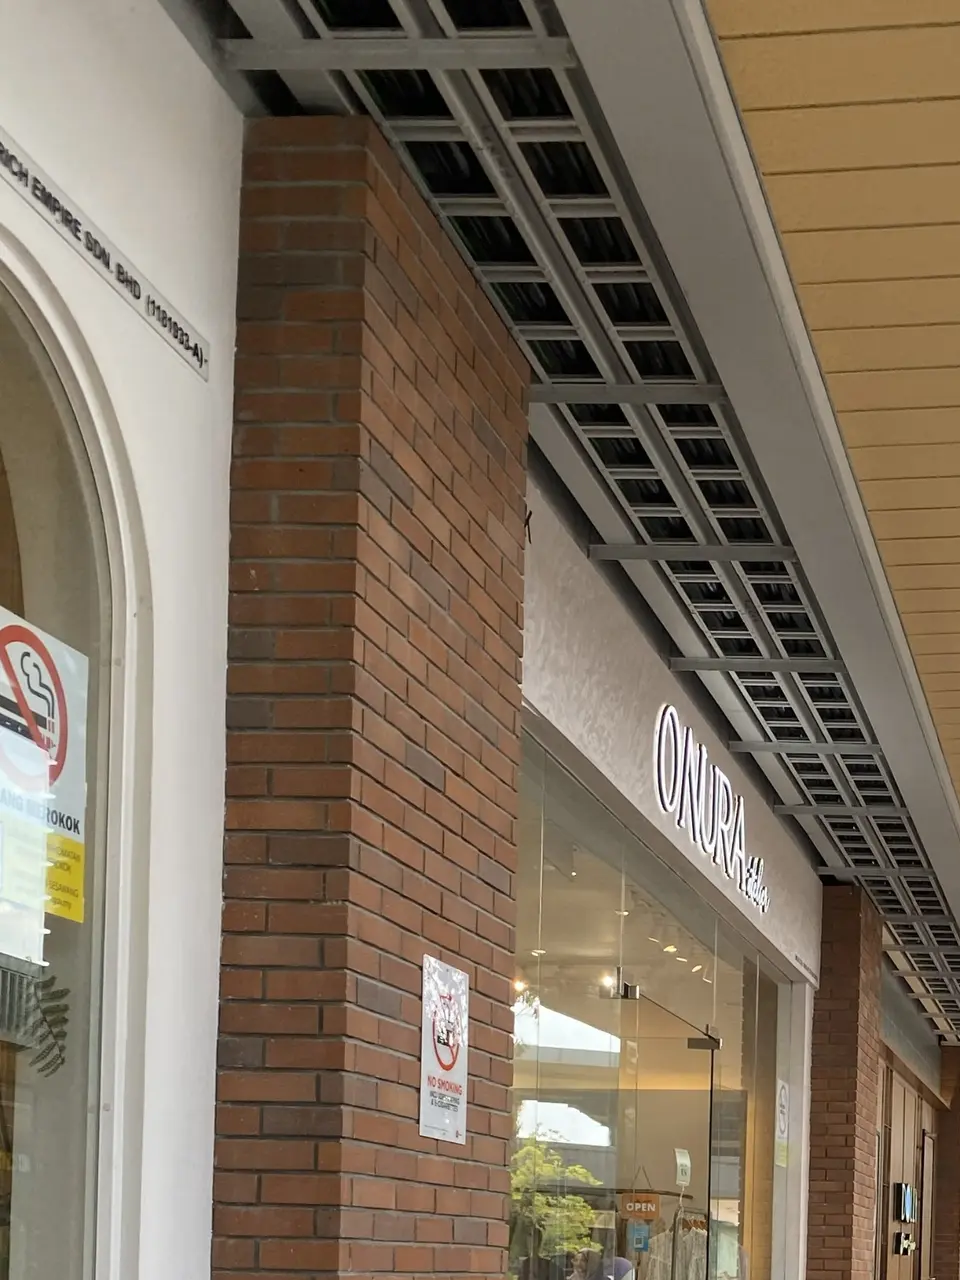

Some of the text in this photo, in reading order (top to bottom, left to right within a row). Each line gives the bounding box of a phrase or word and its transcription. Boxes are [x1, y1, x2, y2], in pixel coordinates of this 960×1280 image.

[31, 176, 82, 242] EMPIRE
[116, 262, 141, 300] BHD
[653, 702, 748, 893] ONURA
[427, 1075, 463, 1096] NO SMOKING
[626, 1203, 656, 1212] OPEN
